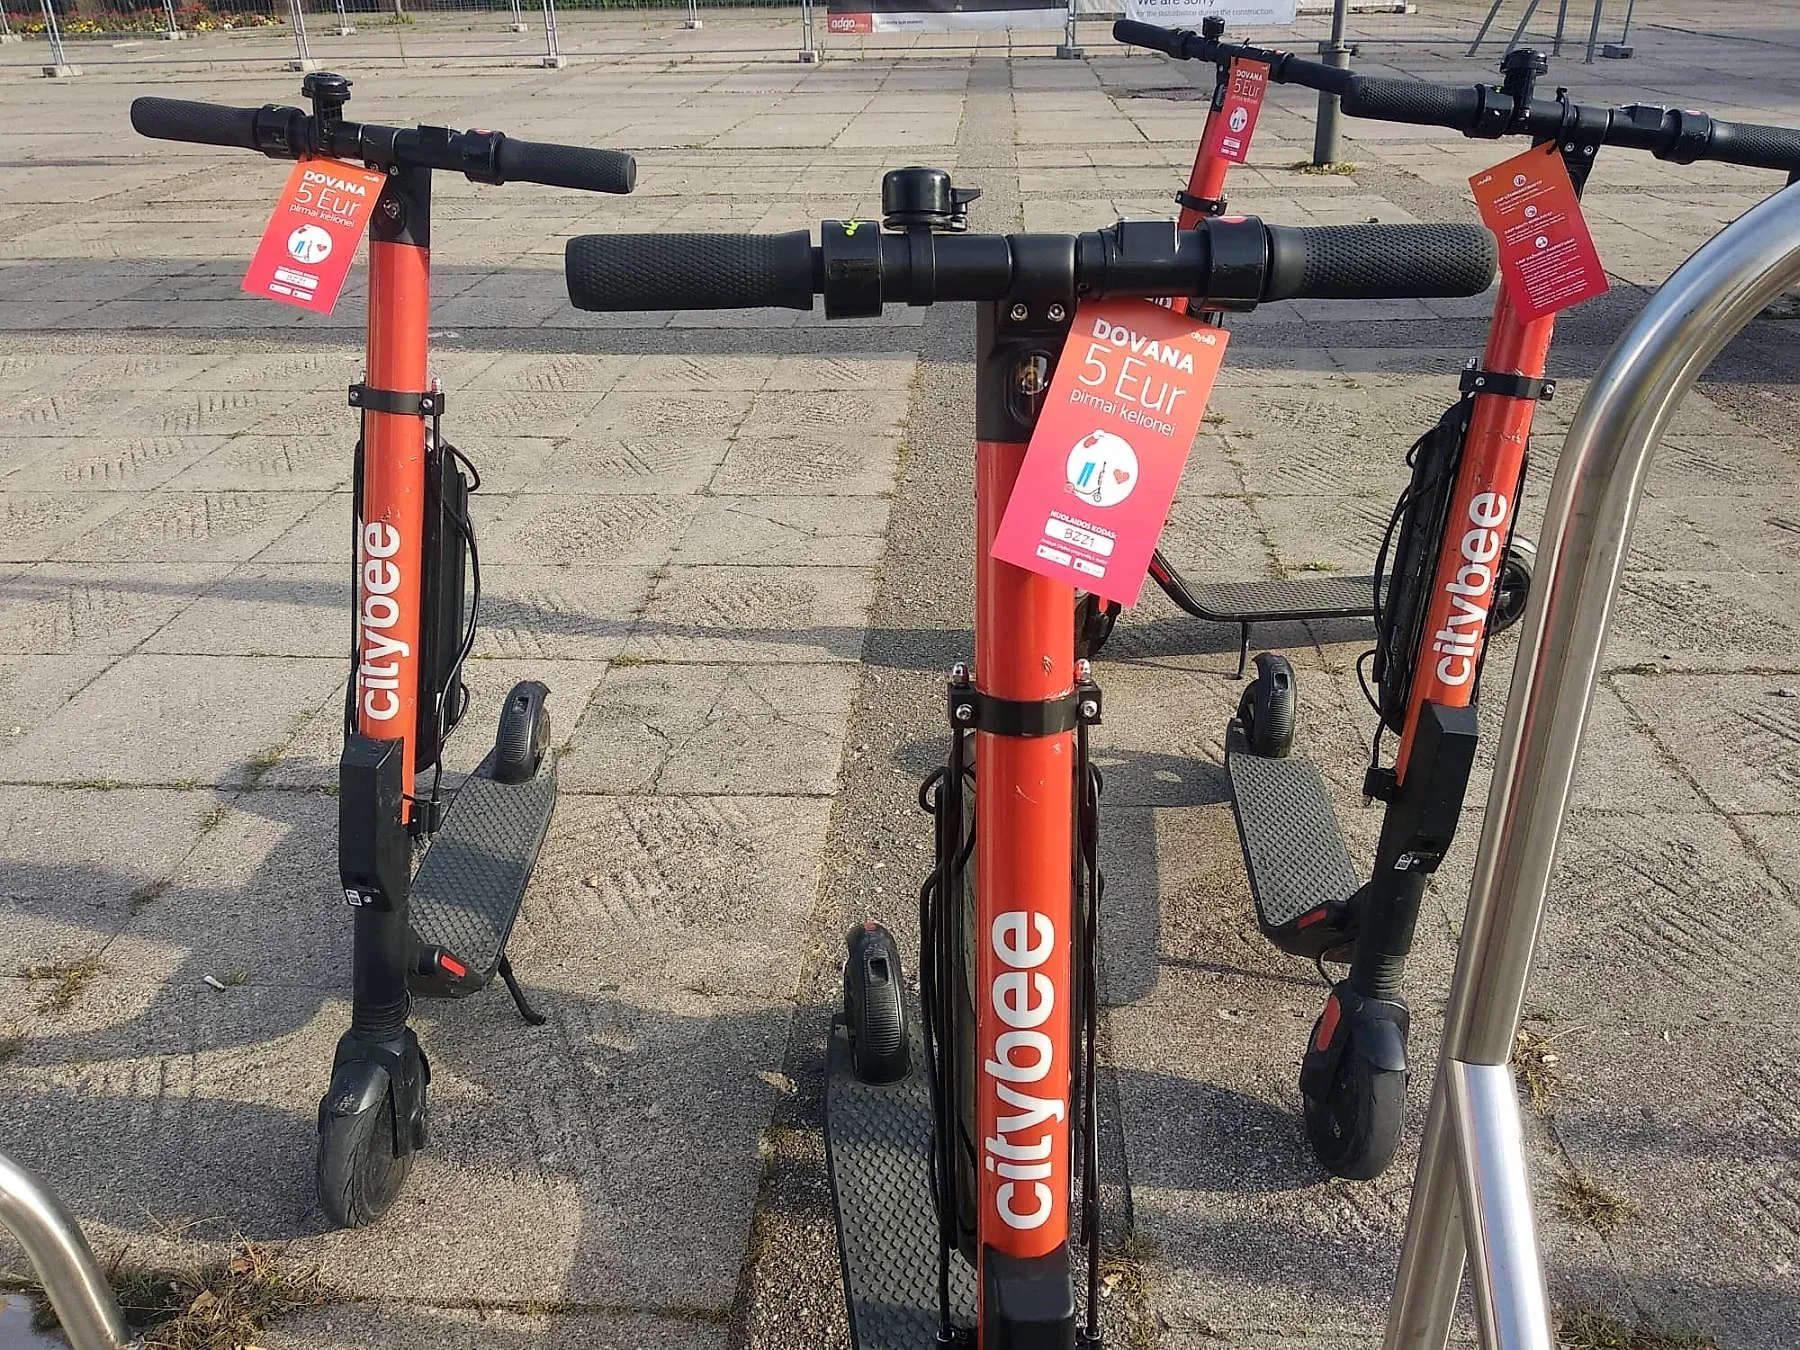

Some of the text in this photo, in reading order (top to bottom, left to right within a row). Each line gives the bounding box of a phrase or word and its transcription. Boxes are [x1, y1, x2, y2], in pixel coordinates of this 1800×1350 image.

[1233, 78, 1261, 96] 5 Eur
[1236, 69, 1263, 81] DOVANA
[294, 182, 361, 217] 5 Eur
[303, 169, 366, 197] DOVANA
[288, 203, 356, 228] pirmai kelionei
[1092, 318, 1194, 375] DOVANA
[1077, 343, 1187, 416] 5 Eur
[1069, 388, 1177, 437] pirmai kelionei
[1433, 491, 1508, 686] citybee
[361, 521, 410, 720] citybee
[984, 911, 1064, 1230] citybee
